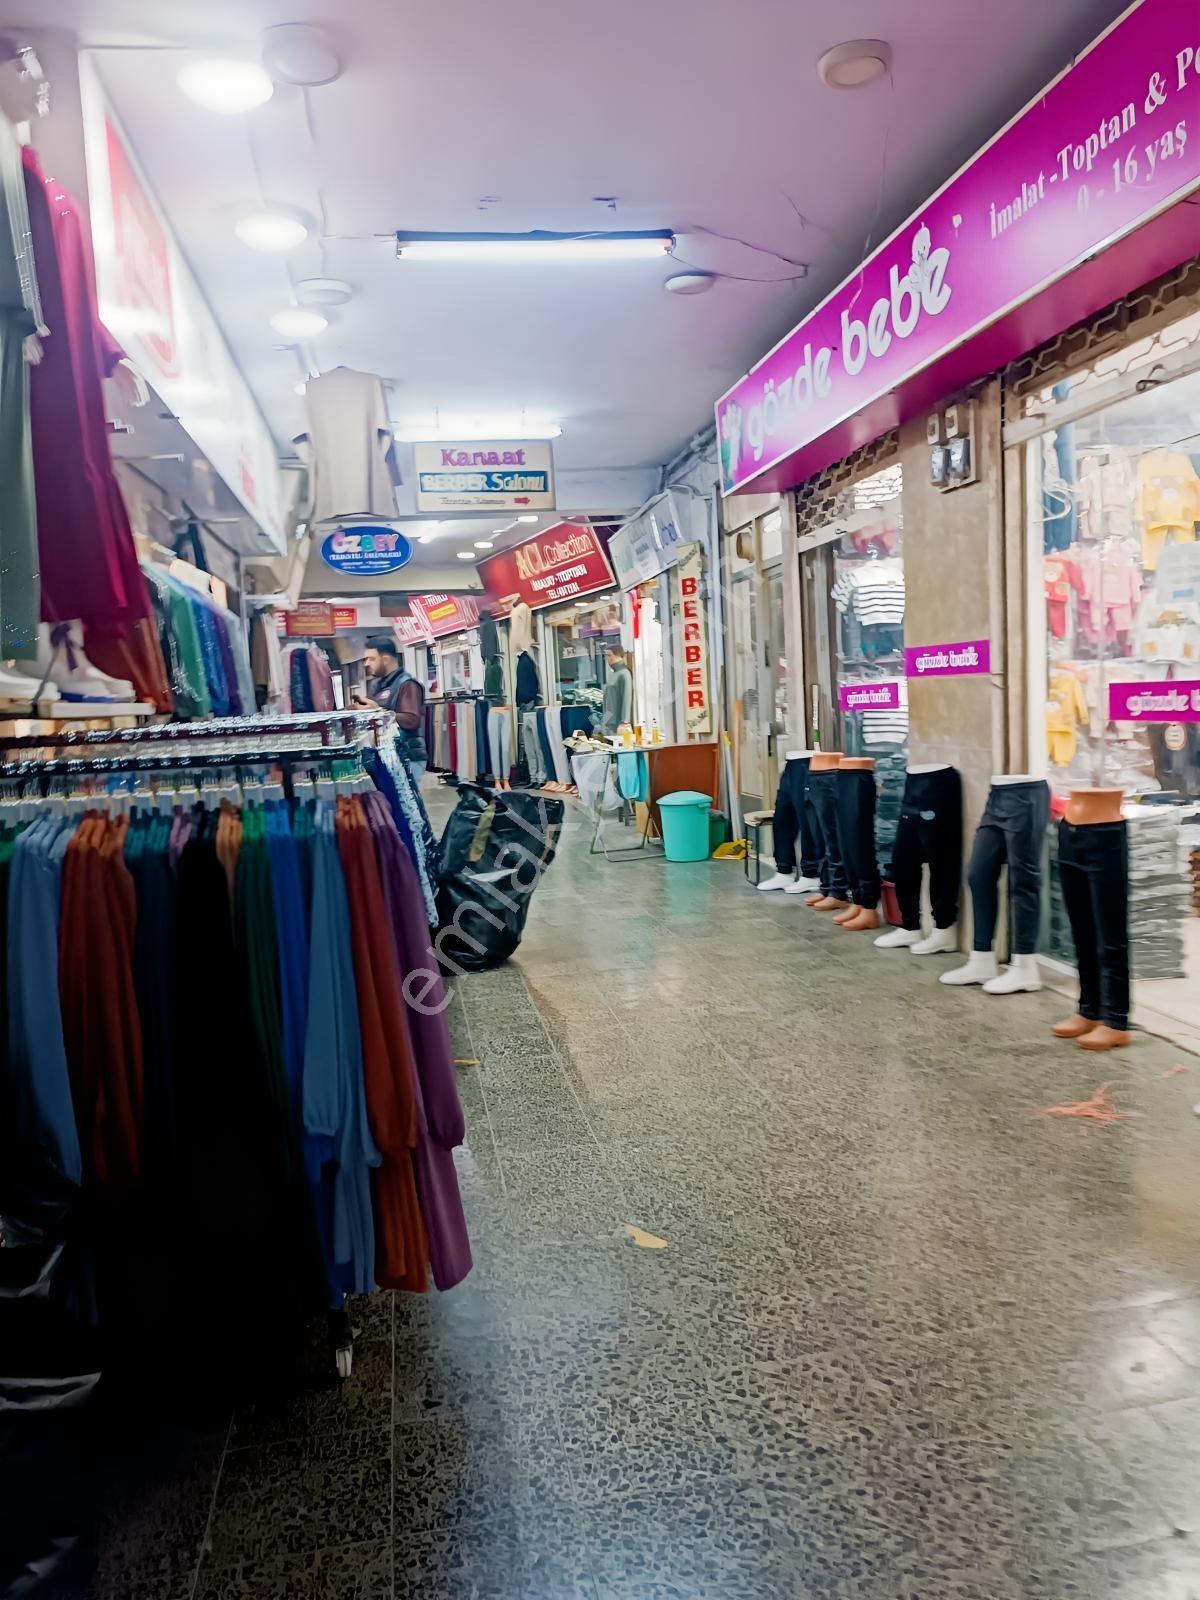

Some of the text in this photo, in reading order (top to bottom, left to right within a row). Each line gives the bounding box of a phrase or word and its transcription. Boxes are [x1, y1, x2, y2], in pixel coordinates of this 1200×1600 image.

[989, 169, 1045, 239] İmalat
[1144, 71, 1168, 115] &
[1112, 144, 1138, 193] 16
[1144, 119, 1188, 182] yaş
[748, 247, 952, 462] gözde bebe
[441, 448, 526, 466] Kanaat
[681, 577, 704, 708] BERBER
[1126, 689, 1190, 717] gözde
